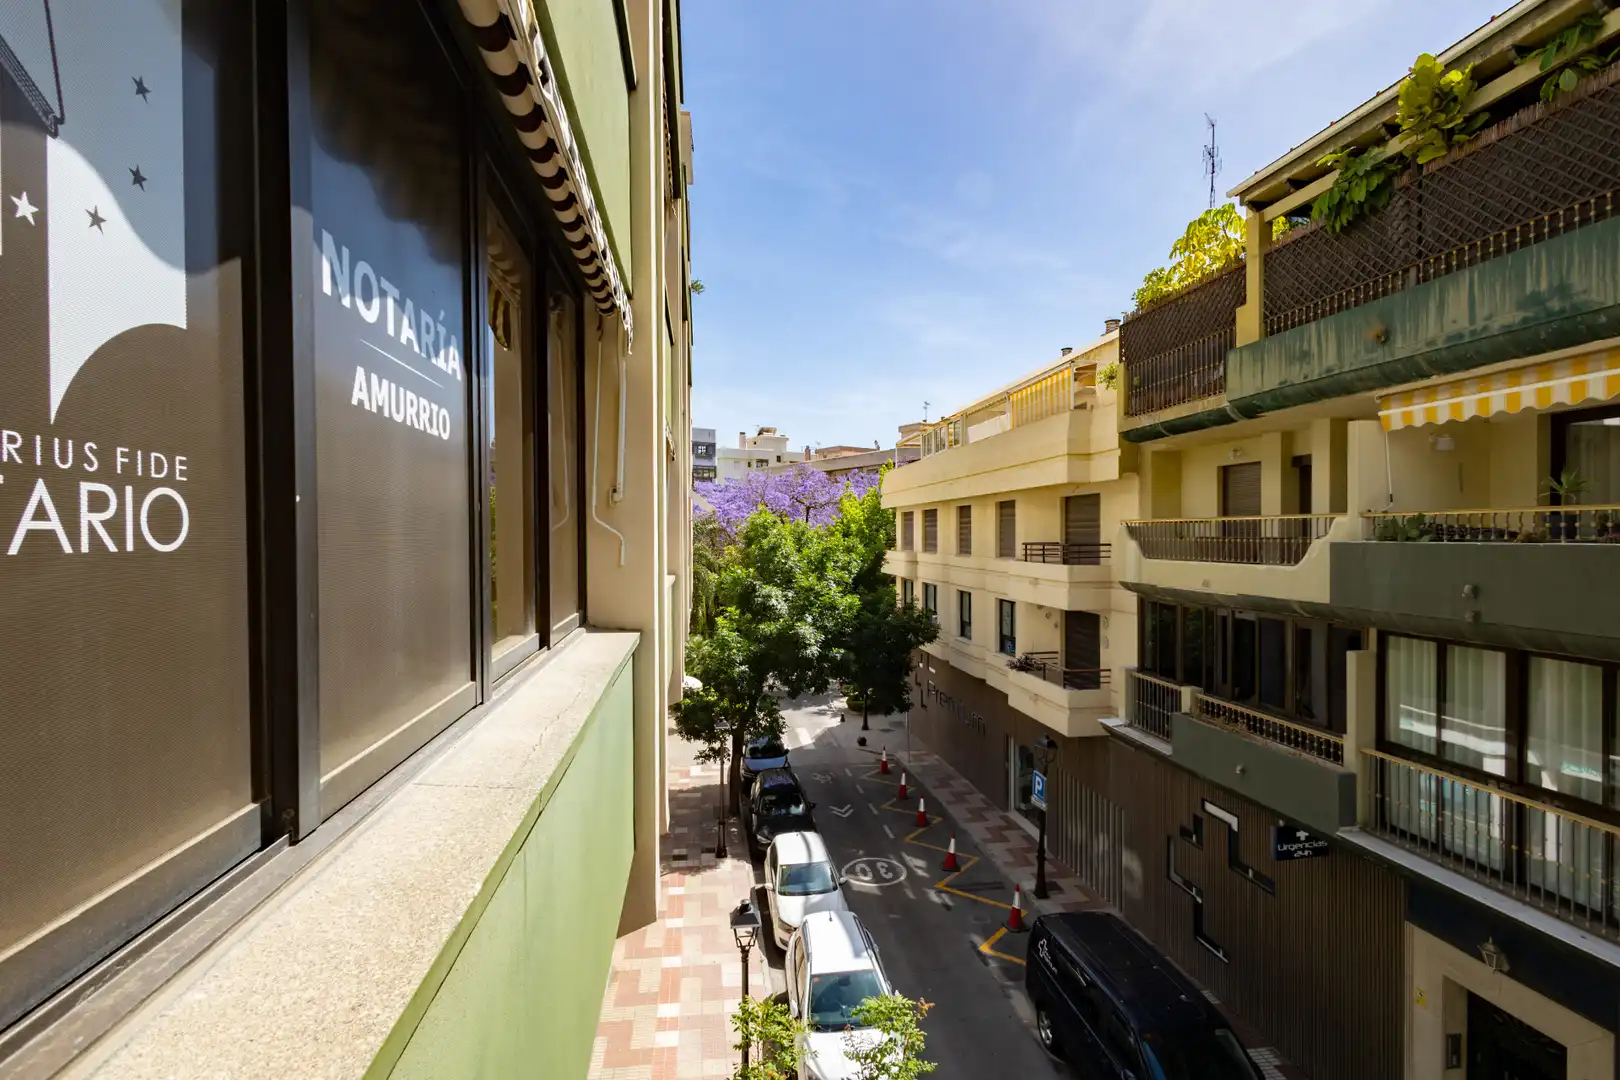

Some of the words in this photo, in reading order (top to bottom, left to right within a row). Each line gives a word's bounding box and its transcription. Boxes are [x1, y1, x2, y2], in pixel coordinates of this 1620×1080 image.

[322, 228, 461, 381] NOTARÍA
[351, 365, 450, 440] AMURRIO
[116, 447, 187, 481] FIDE
[0, 475, 190, 556] ARIO
[1034, 775, 1043, 795] P
[1277, 840, 1328, 851] Urgencias
[855, 861, 893, 881] 30
